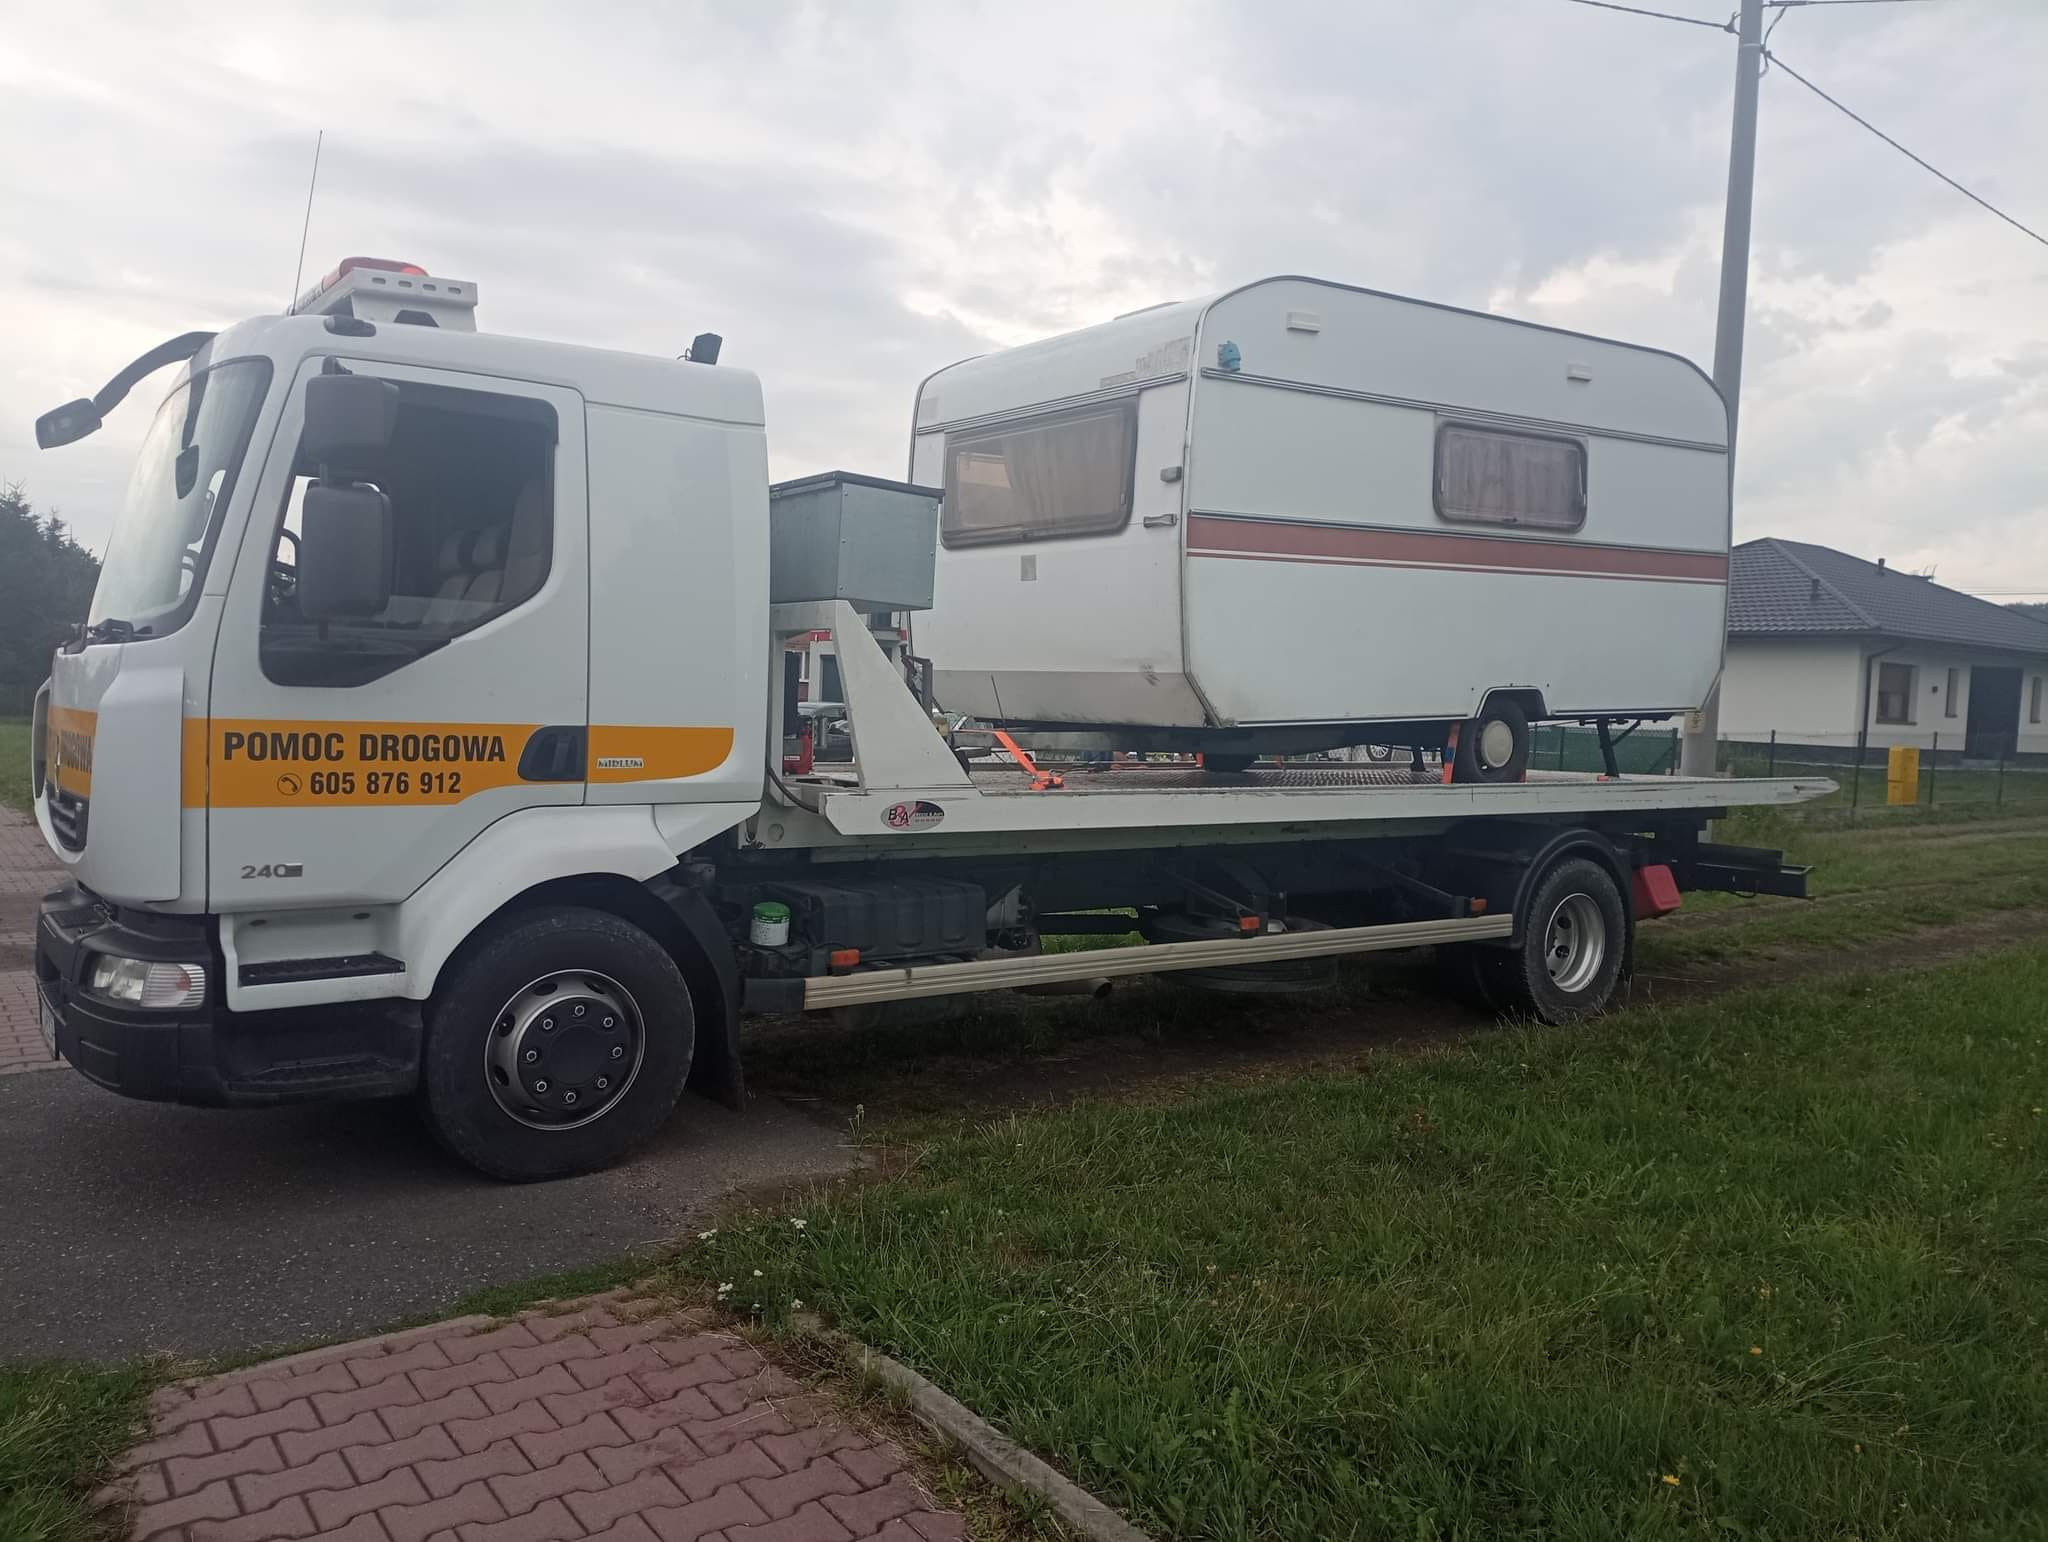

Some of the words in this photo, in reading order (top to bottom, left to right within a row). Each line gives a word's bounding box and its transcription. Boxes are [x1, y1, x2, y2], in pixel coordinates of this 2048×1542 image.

[224, 731, 344, 761] POMOC
[359, 734, 506, 762] DROGOWA
[310, 771, 355, 795] 605
[366, 772, 409, 794] 876
[419, 772, 461, 793] 912
[241, 864, 288, 879] 240
